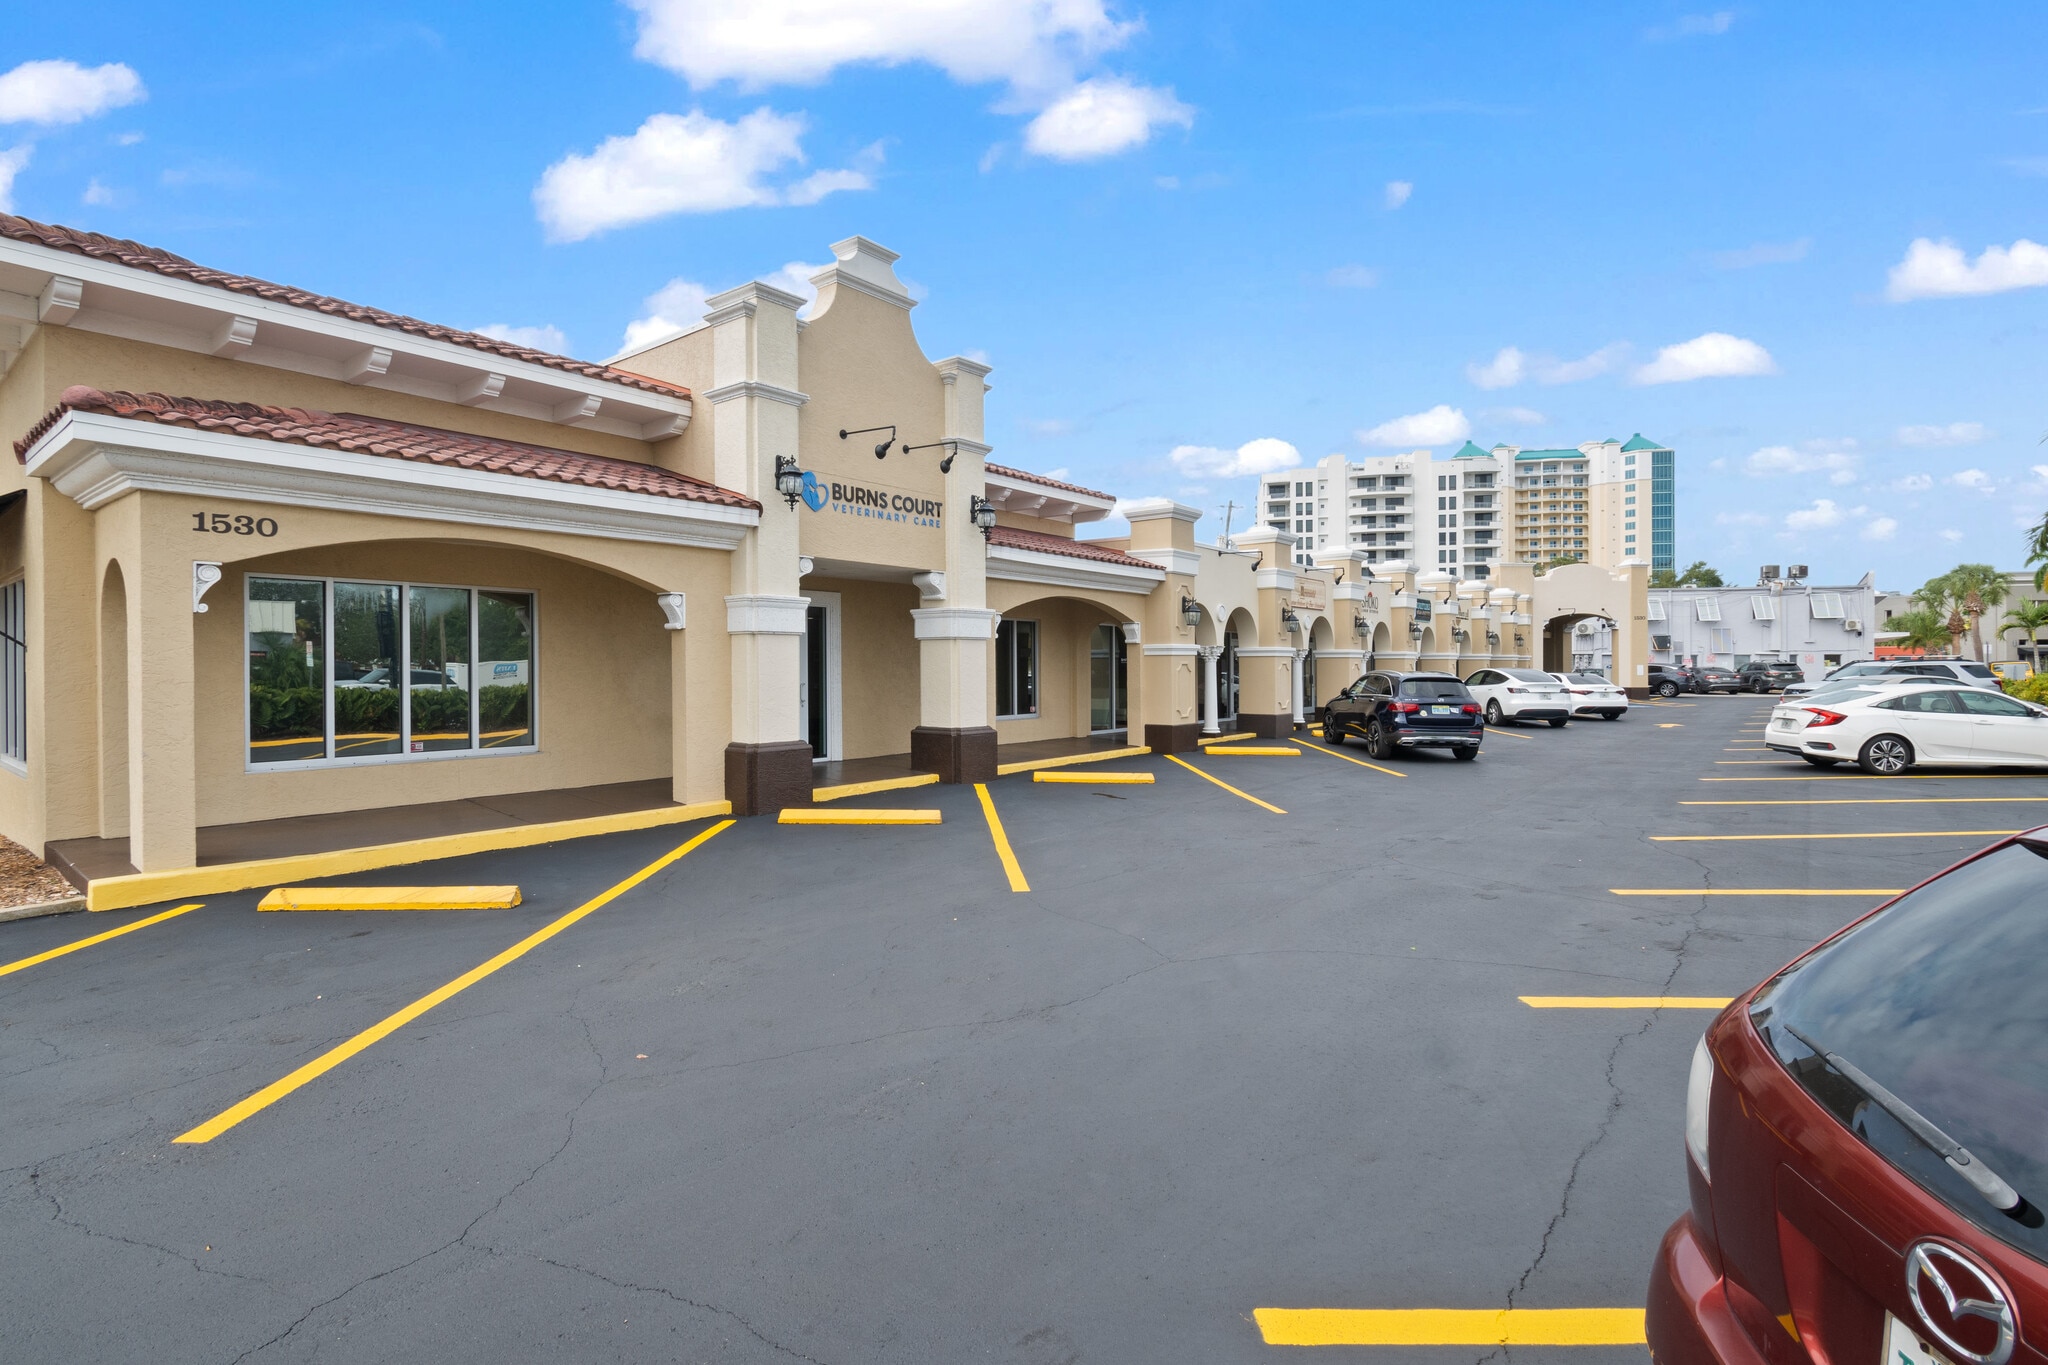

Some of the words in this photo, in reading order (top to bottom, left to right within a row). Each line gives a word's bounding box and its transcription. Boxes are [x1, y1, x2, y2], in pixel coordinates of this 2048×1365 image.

[832, 483, 888, 509] BURNS
[892, 495, 943, 518] COURT
[192, 511, 279, 537] 1530
[832, 503, 908, 523] VETERINARY
[913, 517, 941, 529] CARE
